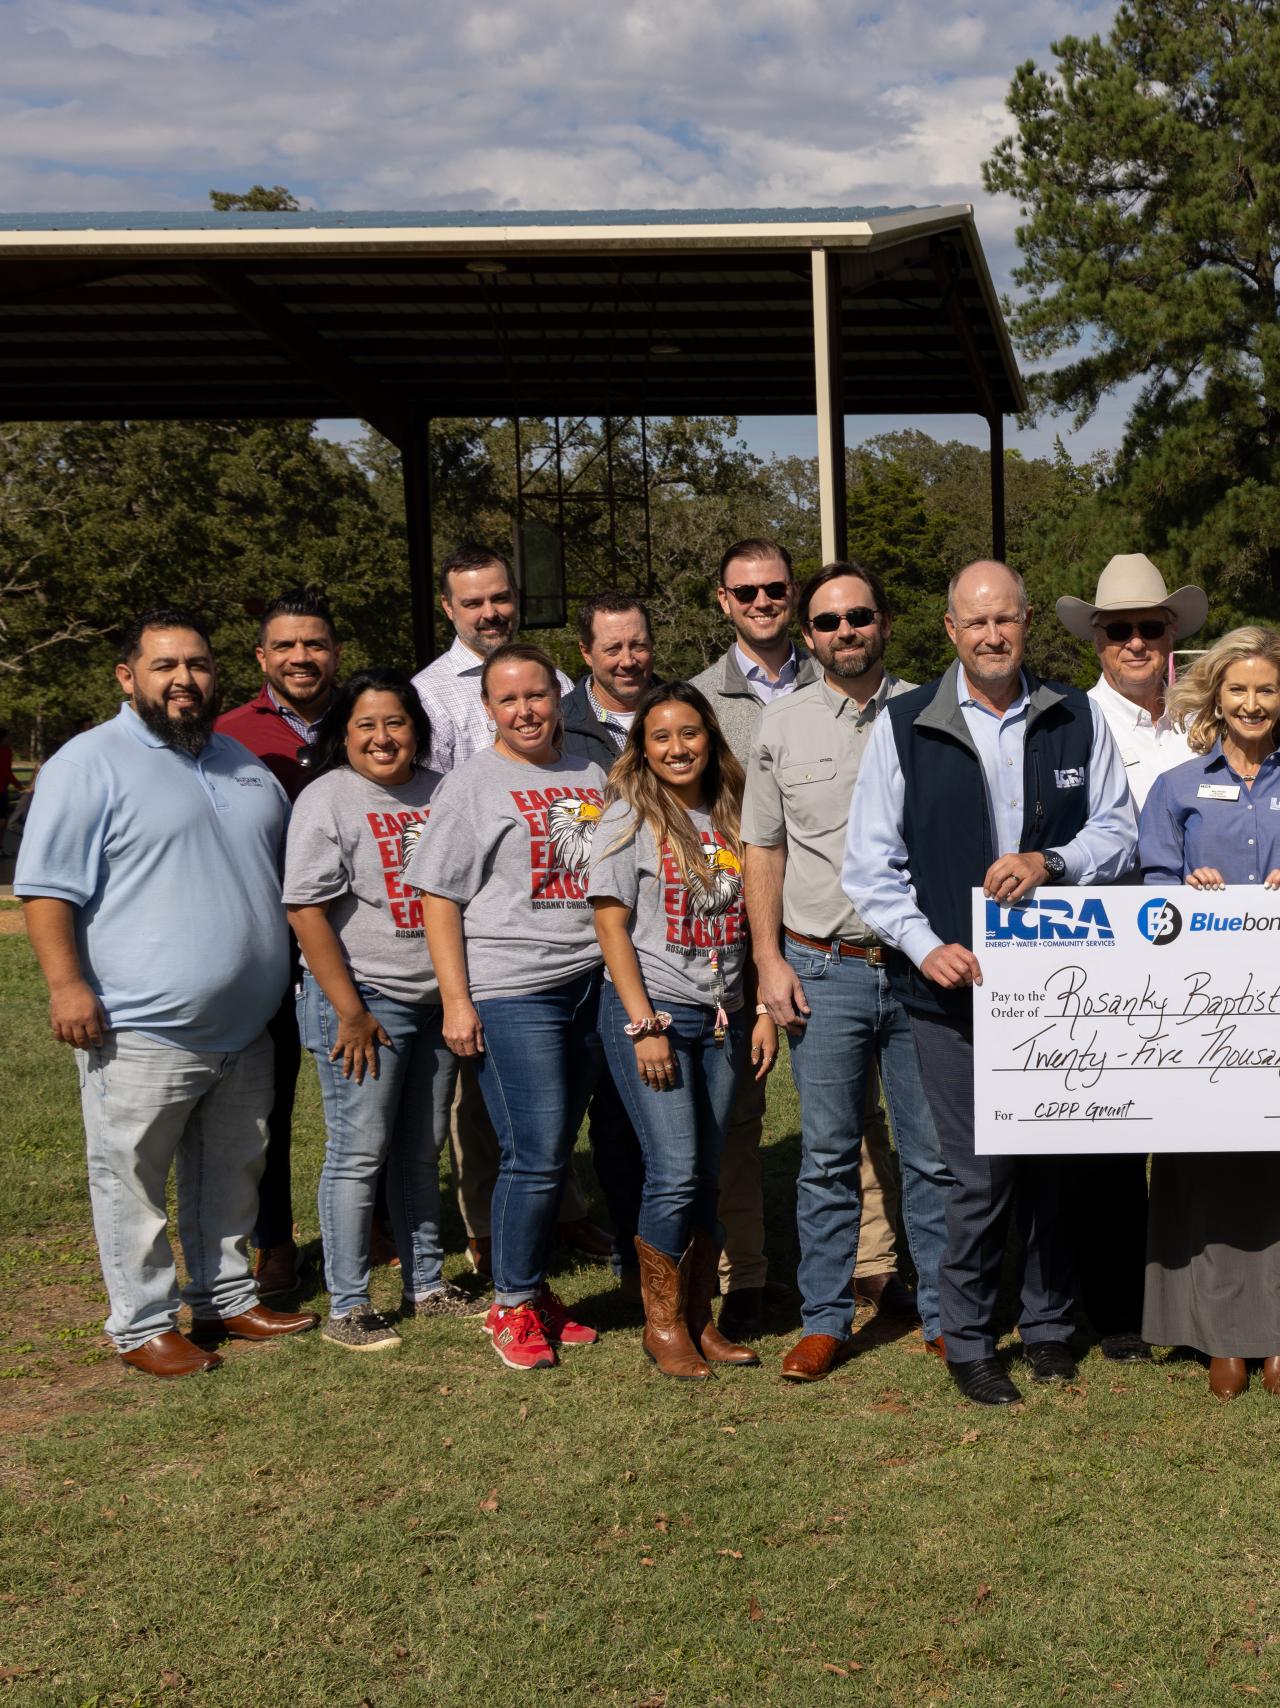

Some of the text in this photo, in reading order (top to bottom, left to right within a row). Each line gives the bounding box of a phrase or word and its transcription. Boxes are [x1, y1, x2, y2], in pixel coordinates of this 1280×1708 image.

[985, 898, 1115, 941] LCRA
[395, 929, 426, 939] ROSANK
[1016, 940, 1038, 948] WATER
[1042, 940, 1084, 948] COMMUNITY
[1086, 939, 1116, 947] SERVICES
[991, 991, 1046, 1005] Pay to the
[1044, 966, 1168, 1040] Rosanky
[991, 1006, 1040, 1018] Order of
[994, 1110, 1014, 1121] For
[1034, 1099, 1136, 1123] CDPP Grant
